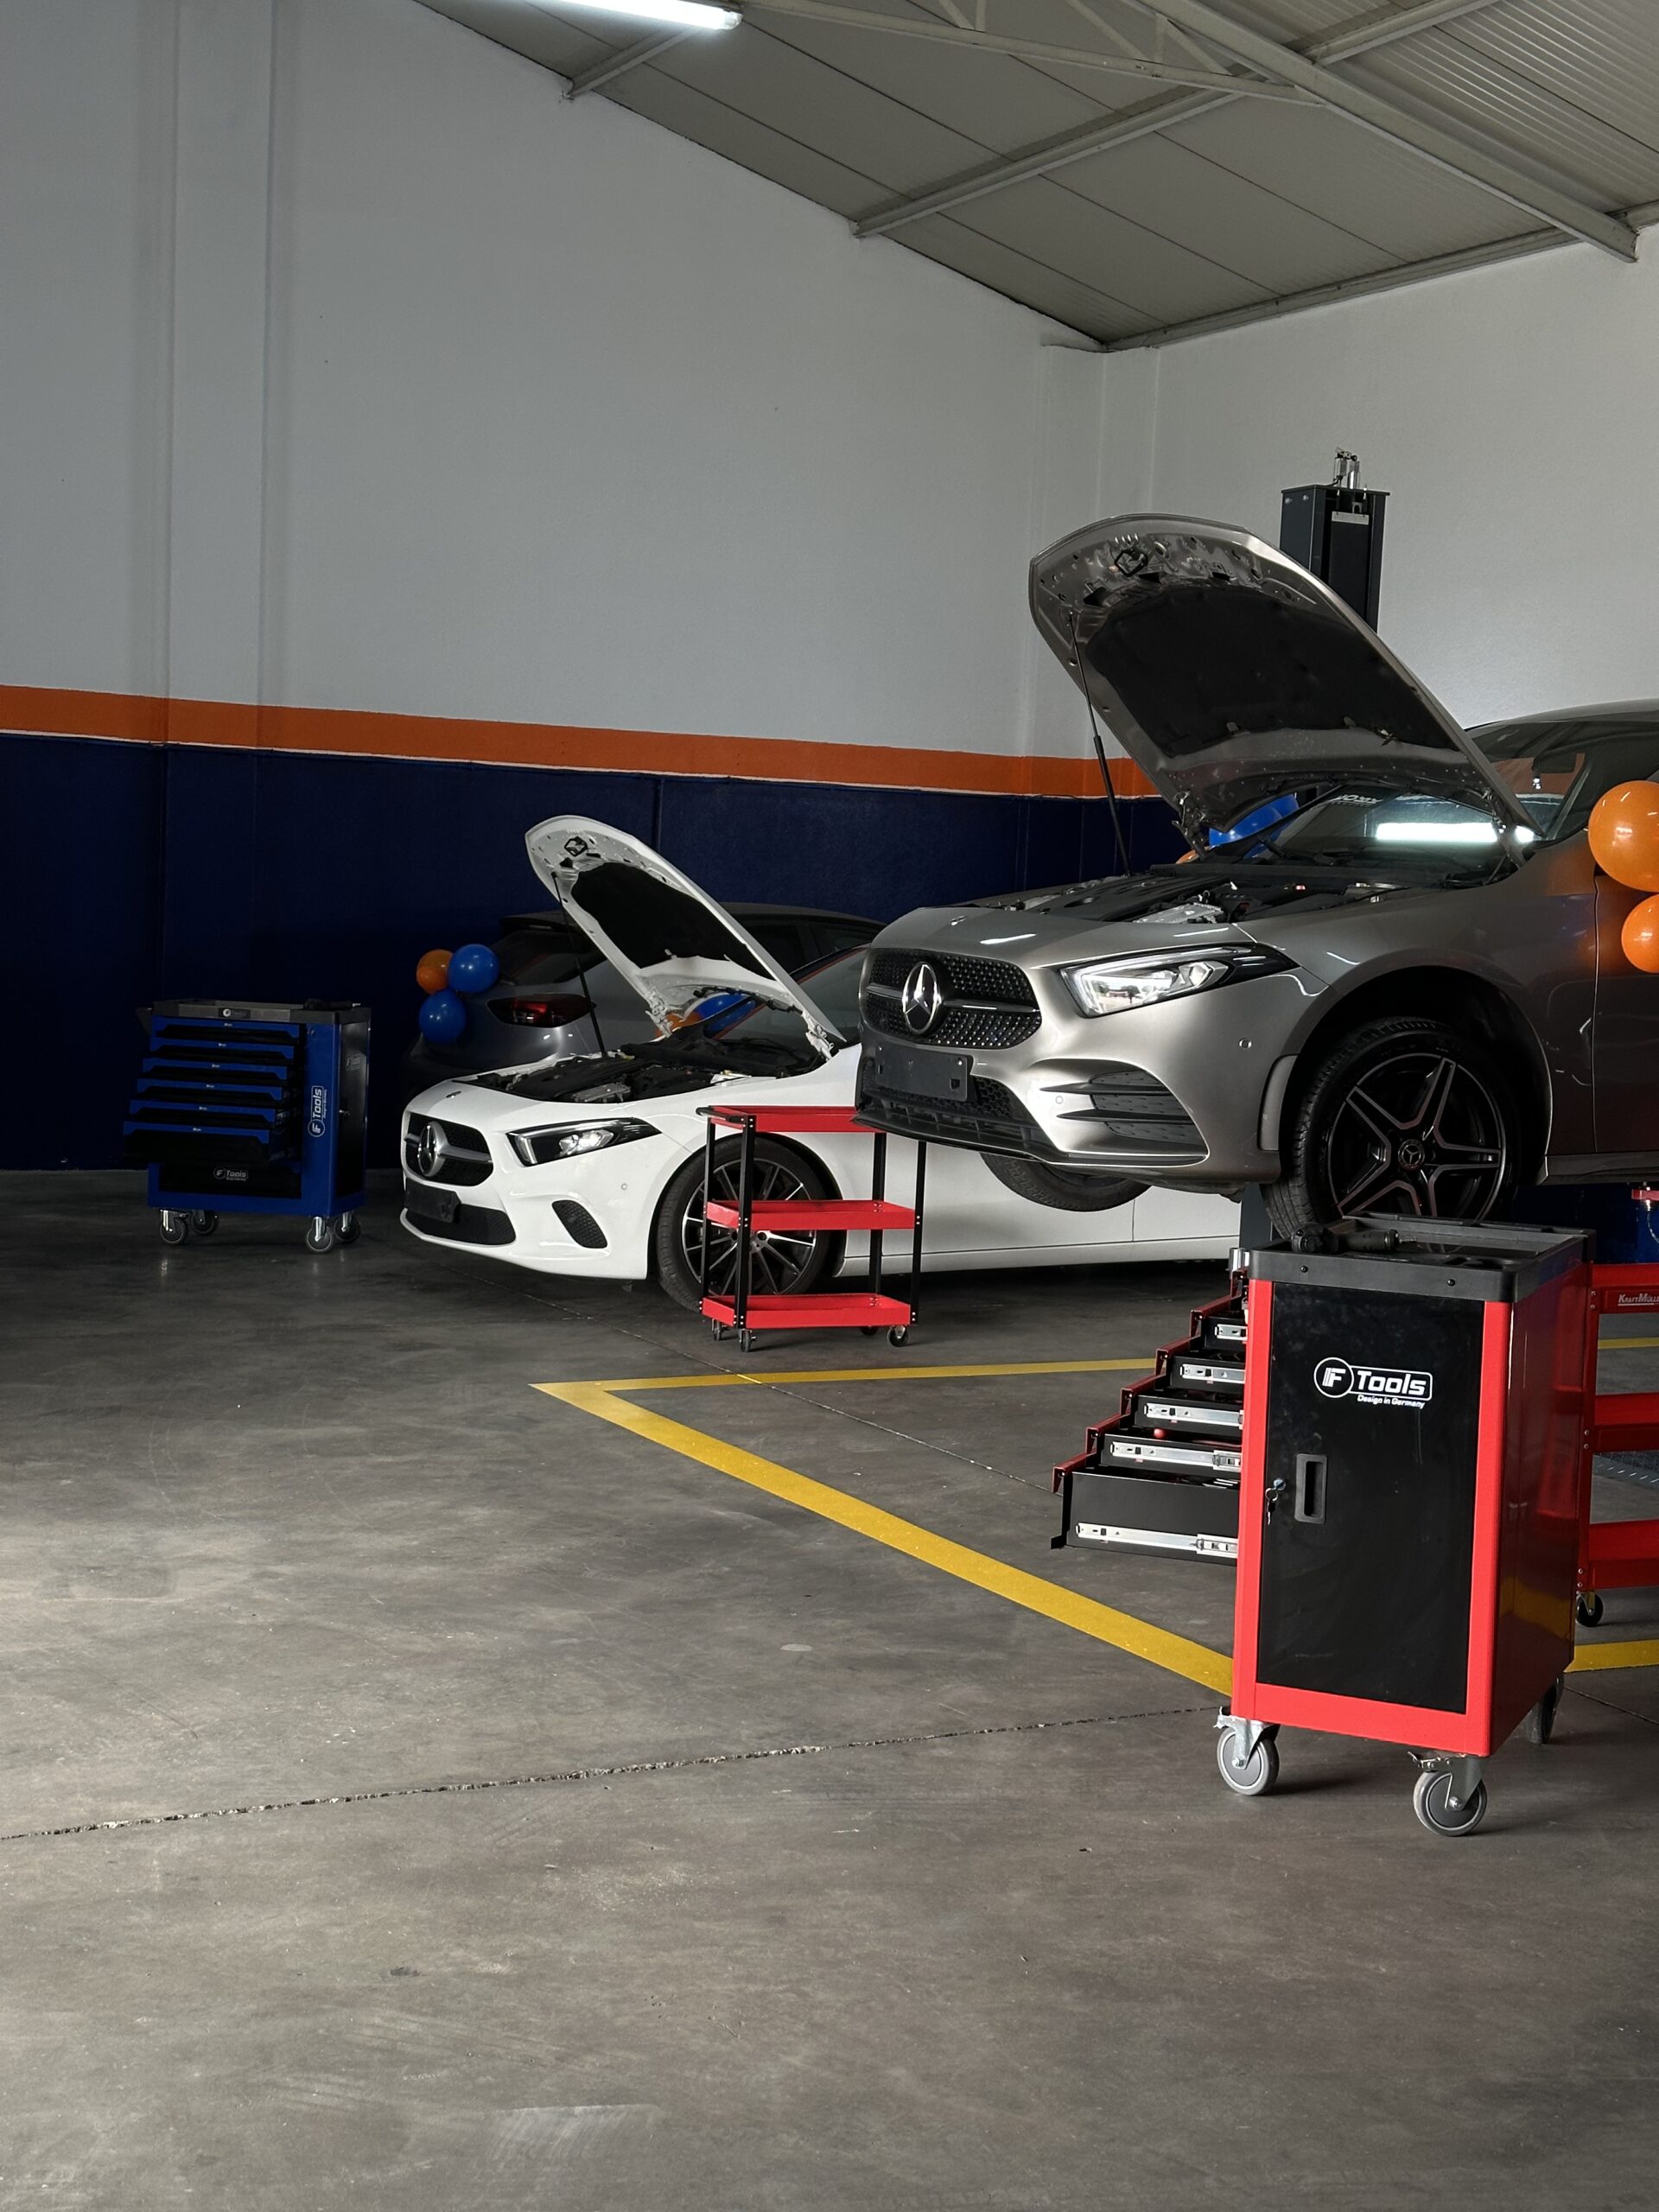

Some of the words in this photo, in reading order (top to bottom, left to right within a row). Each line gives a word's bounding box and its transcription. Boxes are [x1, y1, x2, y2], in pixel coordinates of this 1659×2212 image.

[313, 1088, 322, 1118] Tools
[1357, 1370, 1427, 1395] Tools
[1357, 1394, 1382, 1405] Design
[1391, 1397, 1426, 1409] Germany
